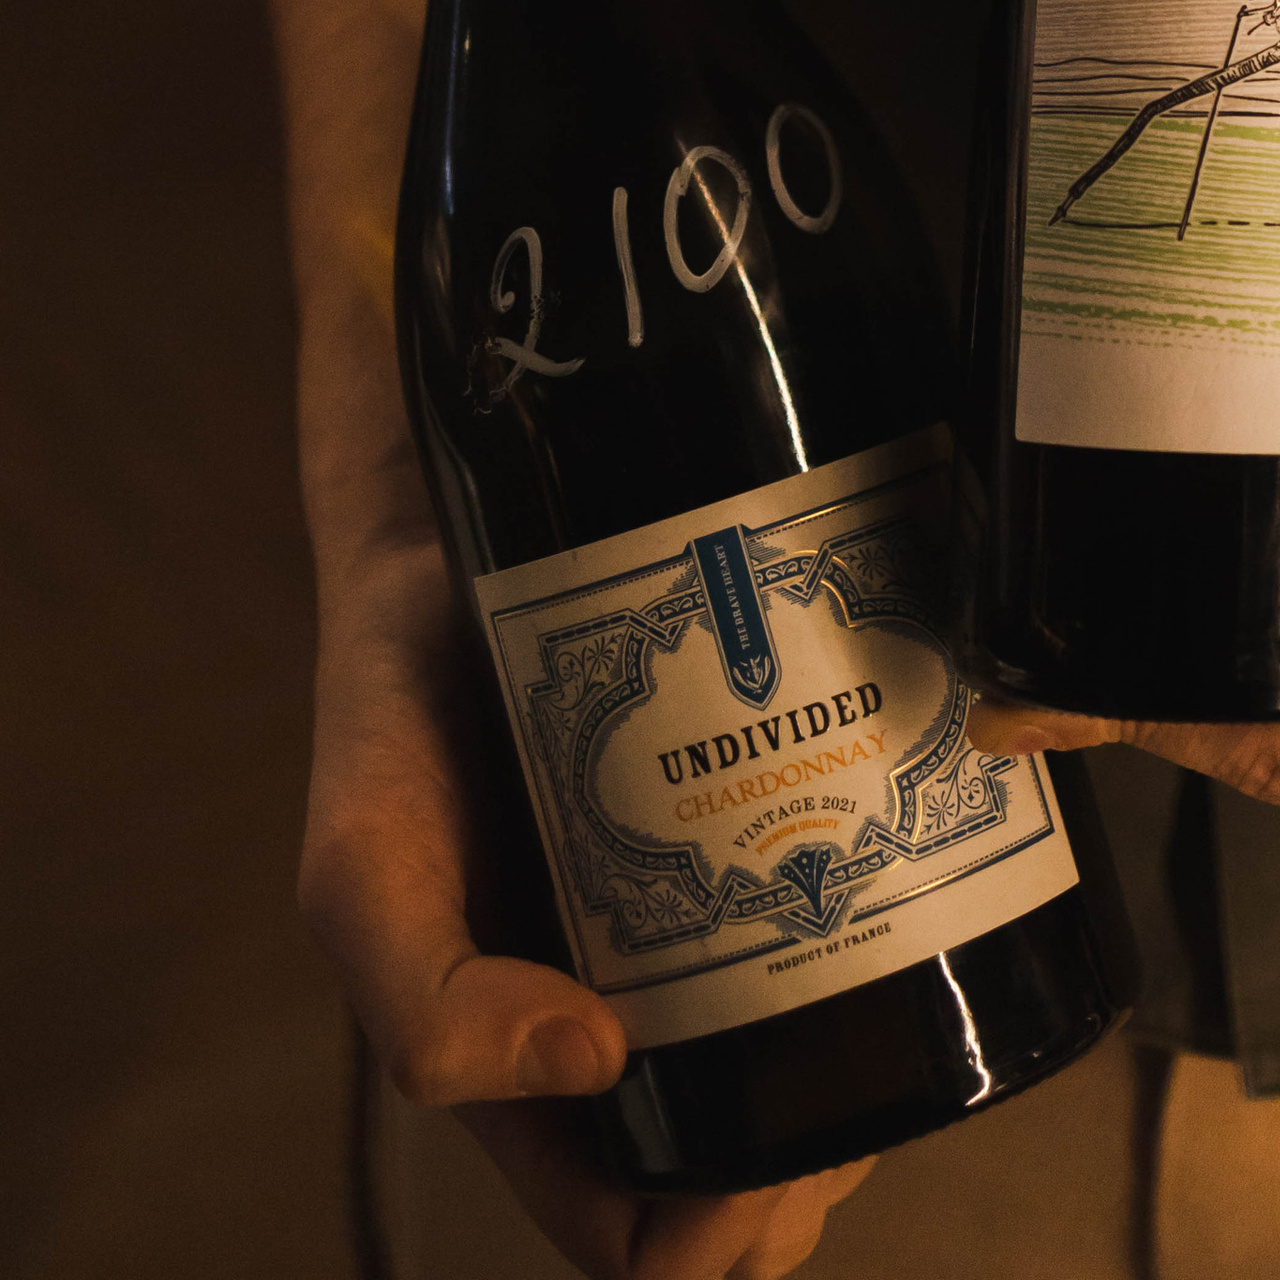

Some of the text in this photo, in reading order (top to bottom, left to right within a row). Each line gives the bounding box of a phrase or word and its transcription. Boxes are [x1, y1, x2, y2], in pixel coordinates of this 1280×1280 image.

[485, 100, 843, 395] 2100
[714, 544, 751, 650] THE BRAVE HEART
[657, 681, 883, 786] UNDIVIDED
[674, 728, 888, 823] CHARDONNAY
[733, 795, 858, 850] VINTAGE 2021
[754, 817, 840, 856] PREMIUM QUALITY
[767, 921, 892, 976] PRODUCT OF FRANCE
